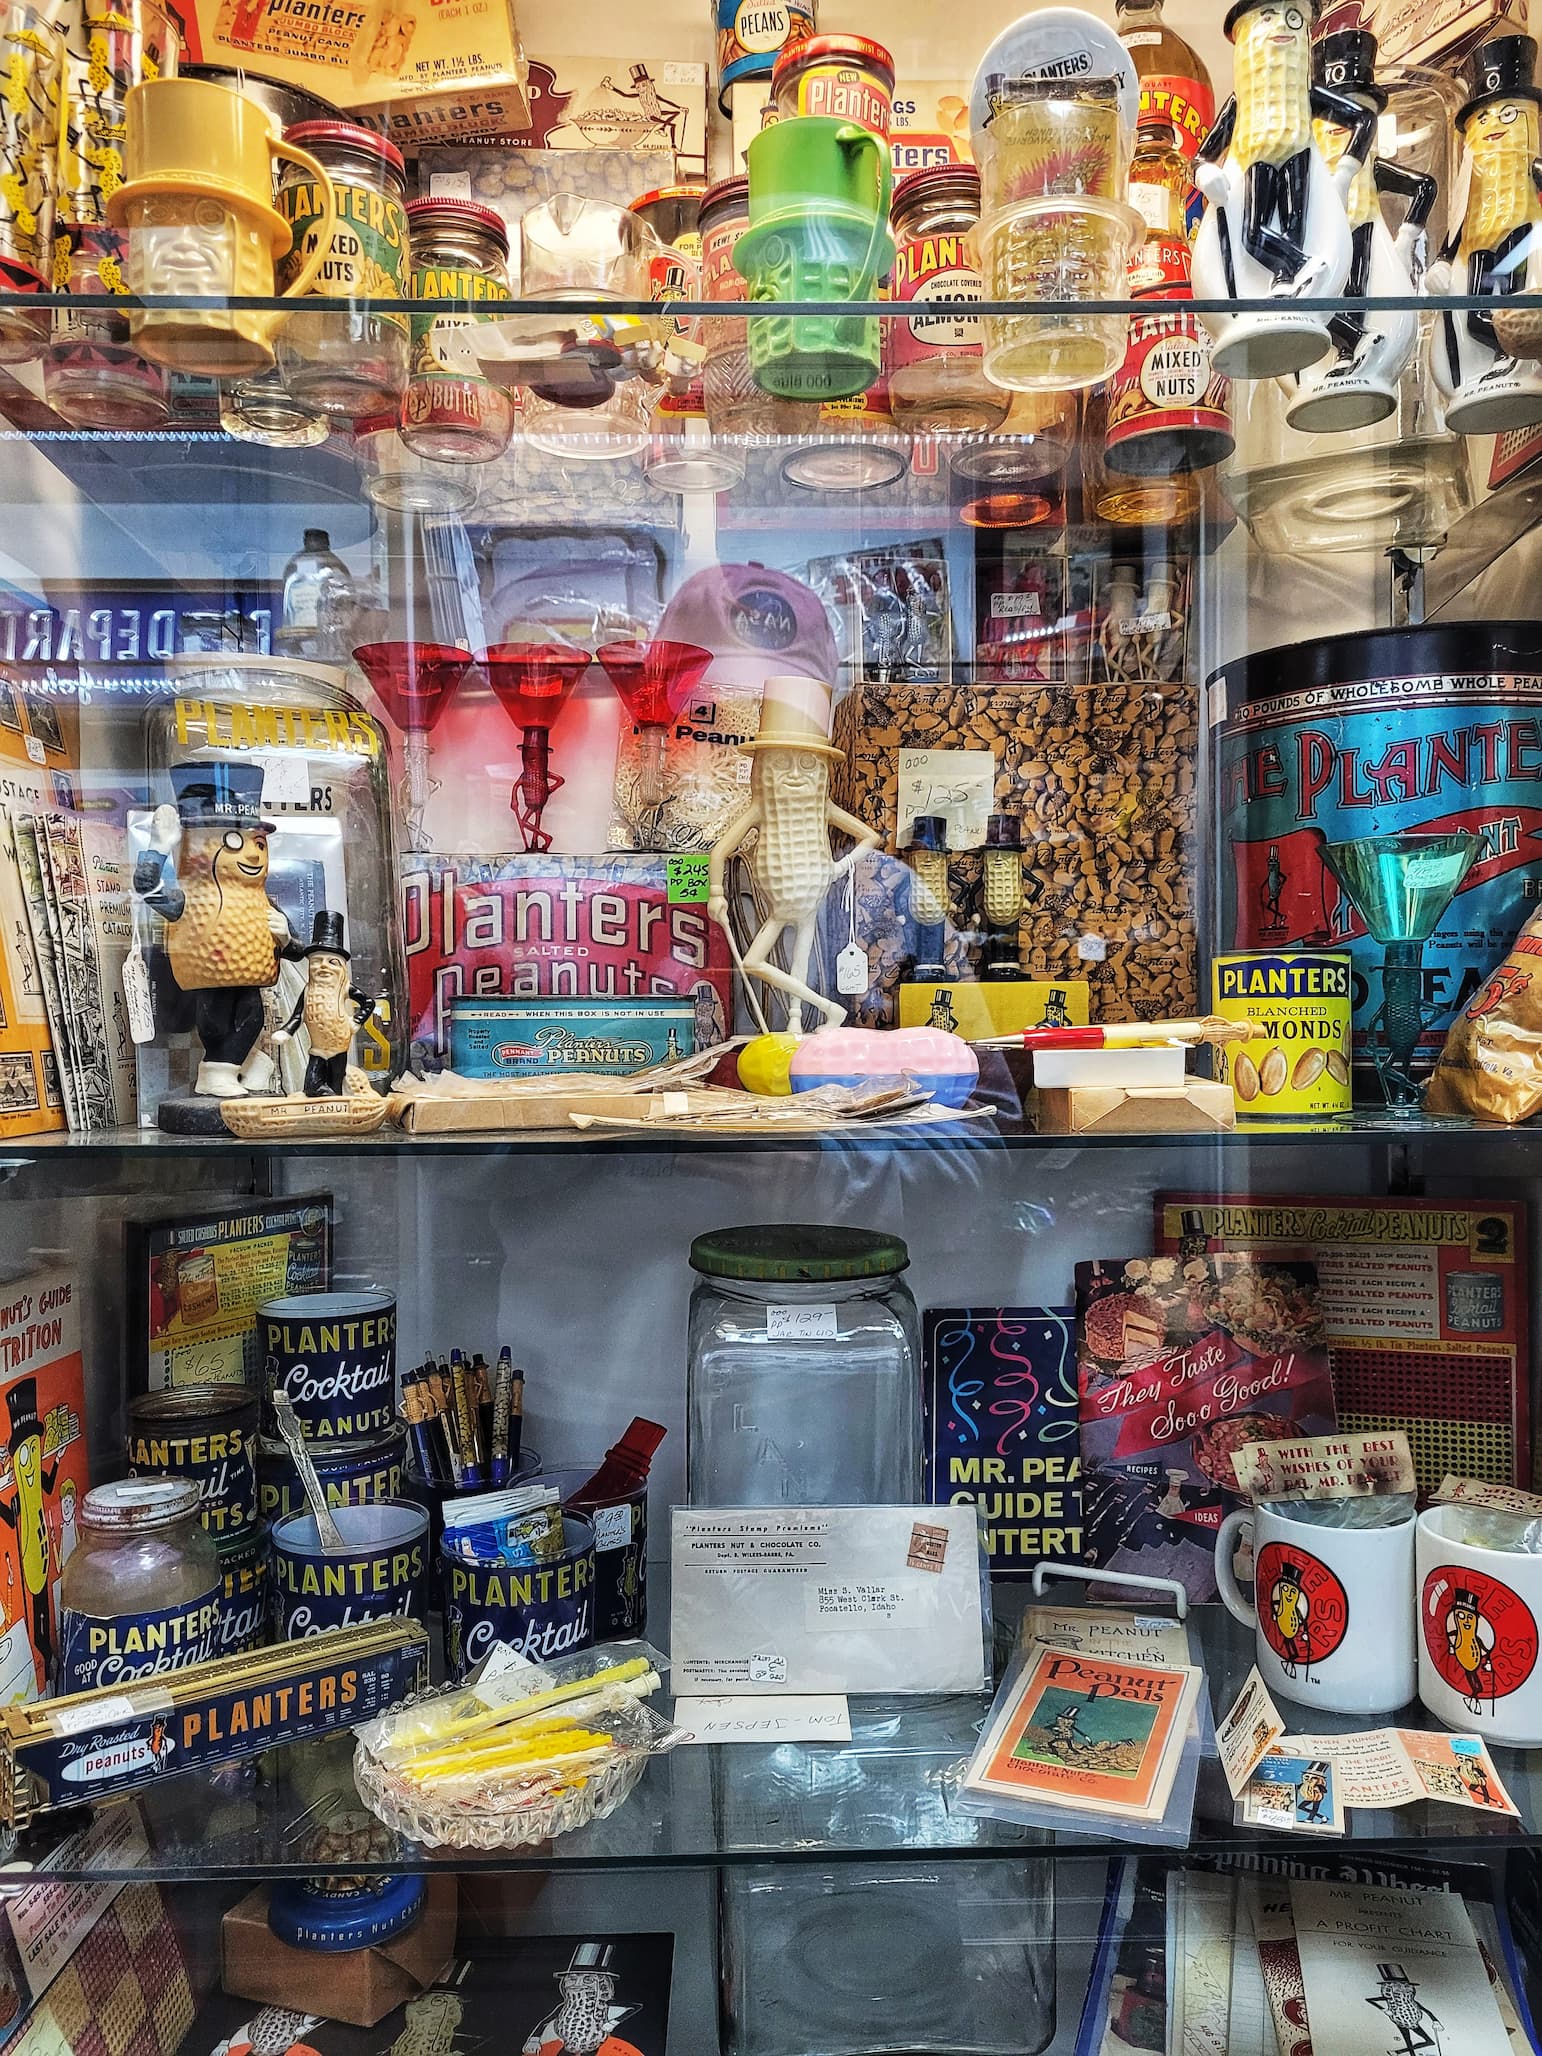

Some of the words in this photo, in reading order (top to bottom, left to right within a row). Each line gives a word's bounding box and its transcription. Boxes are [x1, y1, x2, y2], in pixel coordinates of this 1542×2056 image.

[278, 16, 318, 31] JUMBO
[740, 10, 785, 39] PECANS
[268, 28, 313, 43] PEANUT
[218, 35, 280, 53] PLANTERS
[285, 48, 325, 61] JUMBO
[415, 60, 430, 72] NET
[433, 58, 449, 71] WT.
[468, 53, 486, 66] LBS.
[433, 67, 468, 78] PLANTERS
[471, 62, 504, 73] PEANUTS
[839, 71, 859, 83] NEW
[500, 138, 533, 147] STORE
[712, 235, 731, 249] NEW!
[896, 236, 975, 299] PLANT
[930, 280, 960, 291] CHOCOLATE
[1160, 340, 1191, 352] Salted
[1151, 351, 1201, 372] MIXED
[1156, 378, 1196, 398] NUTS
[1252, 695, 1301, 715] POUNDS
[1304, 690, 1325, 705] OF
[1331, 678, 1444, 700] WHOLESOME
[1449, 675, 1506, 689] WHOLE
[693, 705, 710, 718] 4
[175, 699, 379, 756] PLANTERS
[904, 754, 929, 770] 000
[1231, 745, 1288, 806] HE
[214, 802, 238, 814] MR.
[668, 857, 684, 866] 000
[674, 862, 709, 876] $245
[96, 879, 121, 894] STAMP
[306, 872, 314, 888] THE
[688, 877, 708, 888] BOX
[680, 888, 699, 899] 5¢
[100, 900, 131, 915] PREMIUM
[307, 889, 315, 918] PEANUT
[401, 867, 710, 970] Planters
[514, 945, 590, 958] SALTED
[1223, 965, 1348, 995] PLANTERS
[525, 1010, 551, 1018] WHEN
[554, 1010, 573, 1018] THIS
[577, 1010, 597, 1018] BOX
[1246, 1006, 1328, 1017] BLANCHED
[534, 1026, 623, 1050] Planters
[506, 1057, 540, 1065] BRAND
[546, 1048, 646, 1064] PEANUTS
[270, 1106, 288, 1115] MR
[304, 1104, 348, 1115] PEANUT
[217, 1214, 265, 1241] PLANTERS
[1211, 1208, 1306, 1238] PLANTERS
[1305, 1208, 1376, 1243] Cocktail
[1374, 1211, 1468, 1242] PEANUTS
[1348, 1261, 1385, 1271] SALTED
[1388, 1262, 1434, 1272] PEANUTS
[38, 1283, 72, 1315] GUIDE
[1349, 1289, 1385, 1299] SALTED
[1388, 1291, 1434, 1301] PEANUTS
[1386, 1308, 1417, 1316] RECEIVE
[1349, 1317, 1385, 1327] SALTED
[1388, 1319, 1434, 1329] PEANUTS
[267, 1310, 397, 1355] PLANTERS
[1391, 1341, 1403, 1350] Tin
[1407, 1341, 1442, 1352] Planters
[1446, 1343, 1473, 1353] Salted
[1476, 1344, 1510, 1355] Peanuts
[283, 1350, 393, 1404] Cocktail
[1098, 1379, 1162, 1414] They
[1163, 1345, 1227, 1388] Taste
[1212, 1353, 1296, 1412] Good!
[300, 1406, 392, 1438] EANUTS
[1277, 1447, 1314, 1460] WITH
[1325, 1442, 1350, 1456] THE
[1363, 1439, 1396, 1453] BEST
[229, 1465, 246, 1480] TIME
[949, 1457, 1016, 1484] MR.
[1125, 1464, 1159, 1476] RECIPES
[1279, 1461, 1330, 1476] WISHES
[1336, 1458, 1356, 1470] OF
[1359, 1456, 1400, 1470] YOUR
[1319, 1476, 1345, 1488] MR.
[1193, 1511, 1219, 1524] IDEAS
[739, 1525, 768, 1533] Stamp
[760, 1541, 804, 1549] CHOCOLATE
[275, 1546, 423, 1598] PLANTERS
[452, 1552, 597, 1608] PLANTERS
[817, 1586, 839, 1595] Miss
[842, 1586, 852, 1595] S.
[856, 1585, 886, 1594] Vallar
[818, 1595, 835, 1605] 855
[837, 1594, 858, 1604] West
[890, 1594, 904, 1603] St.
[818, 1603, 868, 1613] Pocatello,
[871, 1602, 897, 1611] Idaho
[89, 1597, 220, 1655] PLANTERS
[466, 1599, 590, 1665] Cocktail
[1052, 1622, 1080, 1633] MR.
[1088, 1625, 1163, 1638] PEANUT
[74, 1657, 98, 1676] GOOD
[96, 1629, 212, 1688] Cocktail
[81, 1671, 92, 1685] AT
[1046, 1659, 1177, 1692] Peanut
[1310, 1677, 1321, 1685] TM
[1086, 1682, 1165, 1703] Pals
[182, 1669, 358, 1749] PLANTERS
[704, 1717, 787, 1732] JEPSEN
[808, 1714, 844, 1724] TOM
[57, 1740, 92, 1761] Dry
[93, 1725, 141, 1749] Roasted
[1347, 1733, 1386, 1744] HUNGRY
[85, 1745, 146, 1777] peanuts
[1365, 1753, 1392, 1763] HABIT
[1329, 1889, 1353, 1900] MR
[1362, 1891, 1424, 1907] PEANUT
[28, 1940, 45, 1963] LAST
[44, 1919, 60, 1943] SALE
[60, 1912, 68, 1923] IN
[67, 1888, 84, 1914] EACH
[297, 1926, 363, 1942] Planters
[371, 1917, 394, 1934] Nut
[1316, 1919, 1328, 1929] A
[1335, 1920, 1389, 1934] PROFIT
[1399, 1926, 1453, 1940] CHART
[1332, 1938, 1355, 1948] FOR
[1357, 1941, 1388, 1952] YOUR
[1391, 1945, 1447, 1958] GUIDANCE
